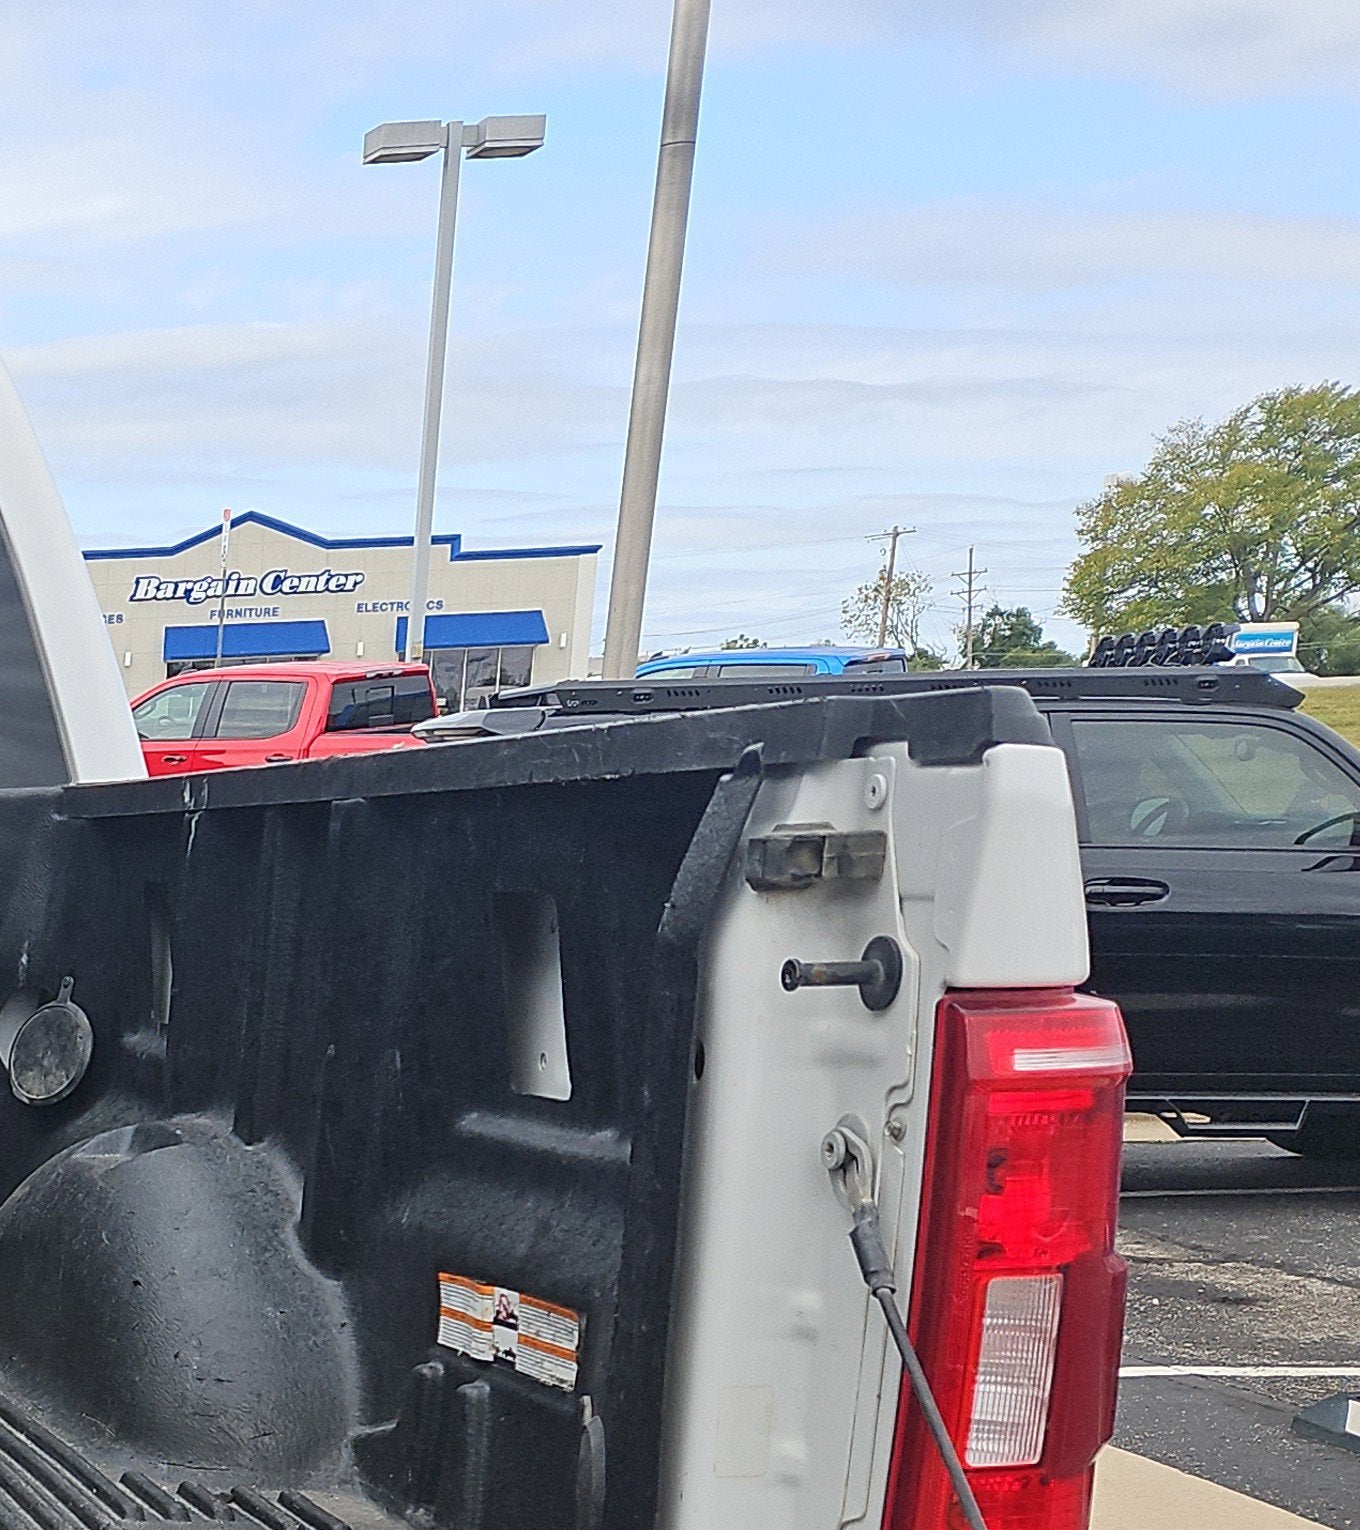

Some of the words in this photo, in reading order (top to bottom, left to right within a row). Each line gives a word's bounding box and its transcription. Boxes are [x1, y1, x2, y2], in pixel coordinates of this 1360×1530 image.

[130, 573, 258, 604] Bargain
[261, 568, 365, 596] Center
[356, 600, 444, 613] ELECTROCS
[210, 607, 279, 620] FURNITURE
